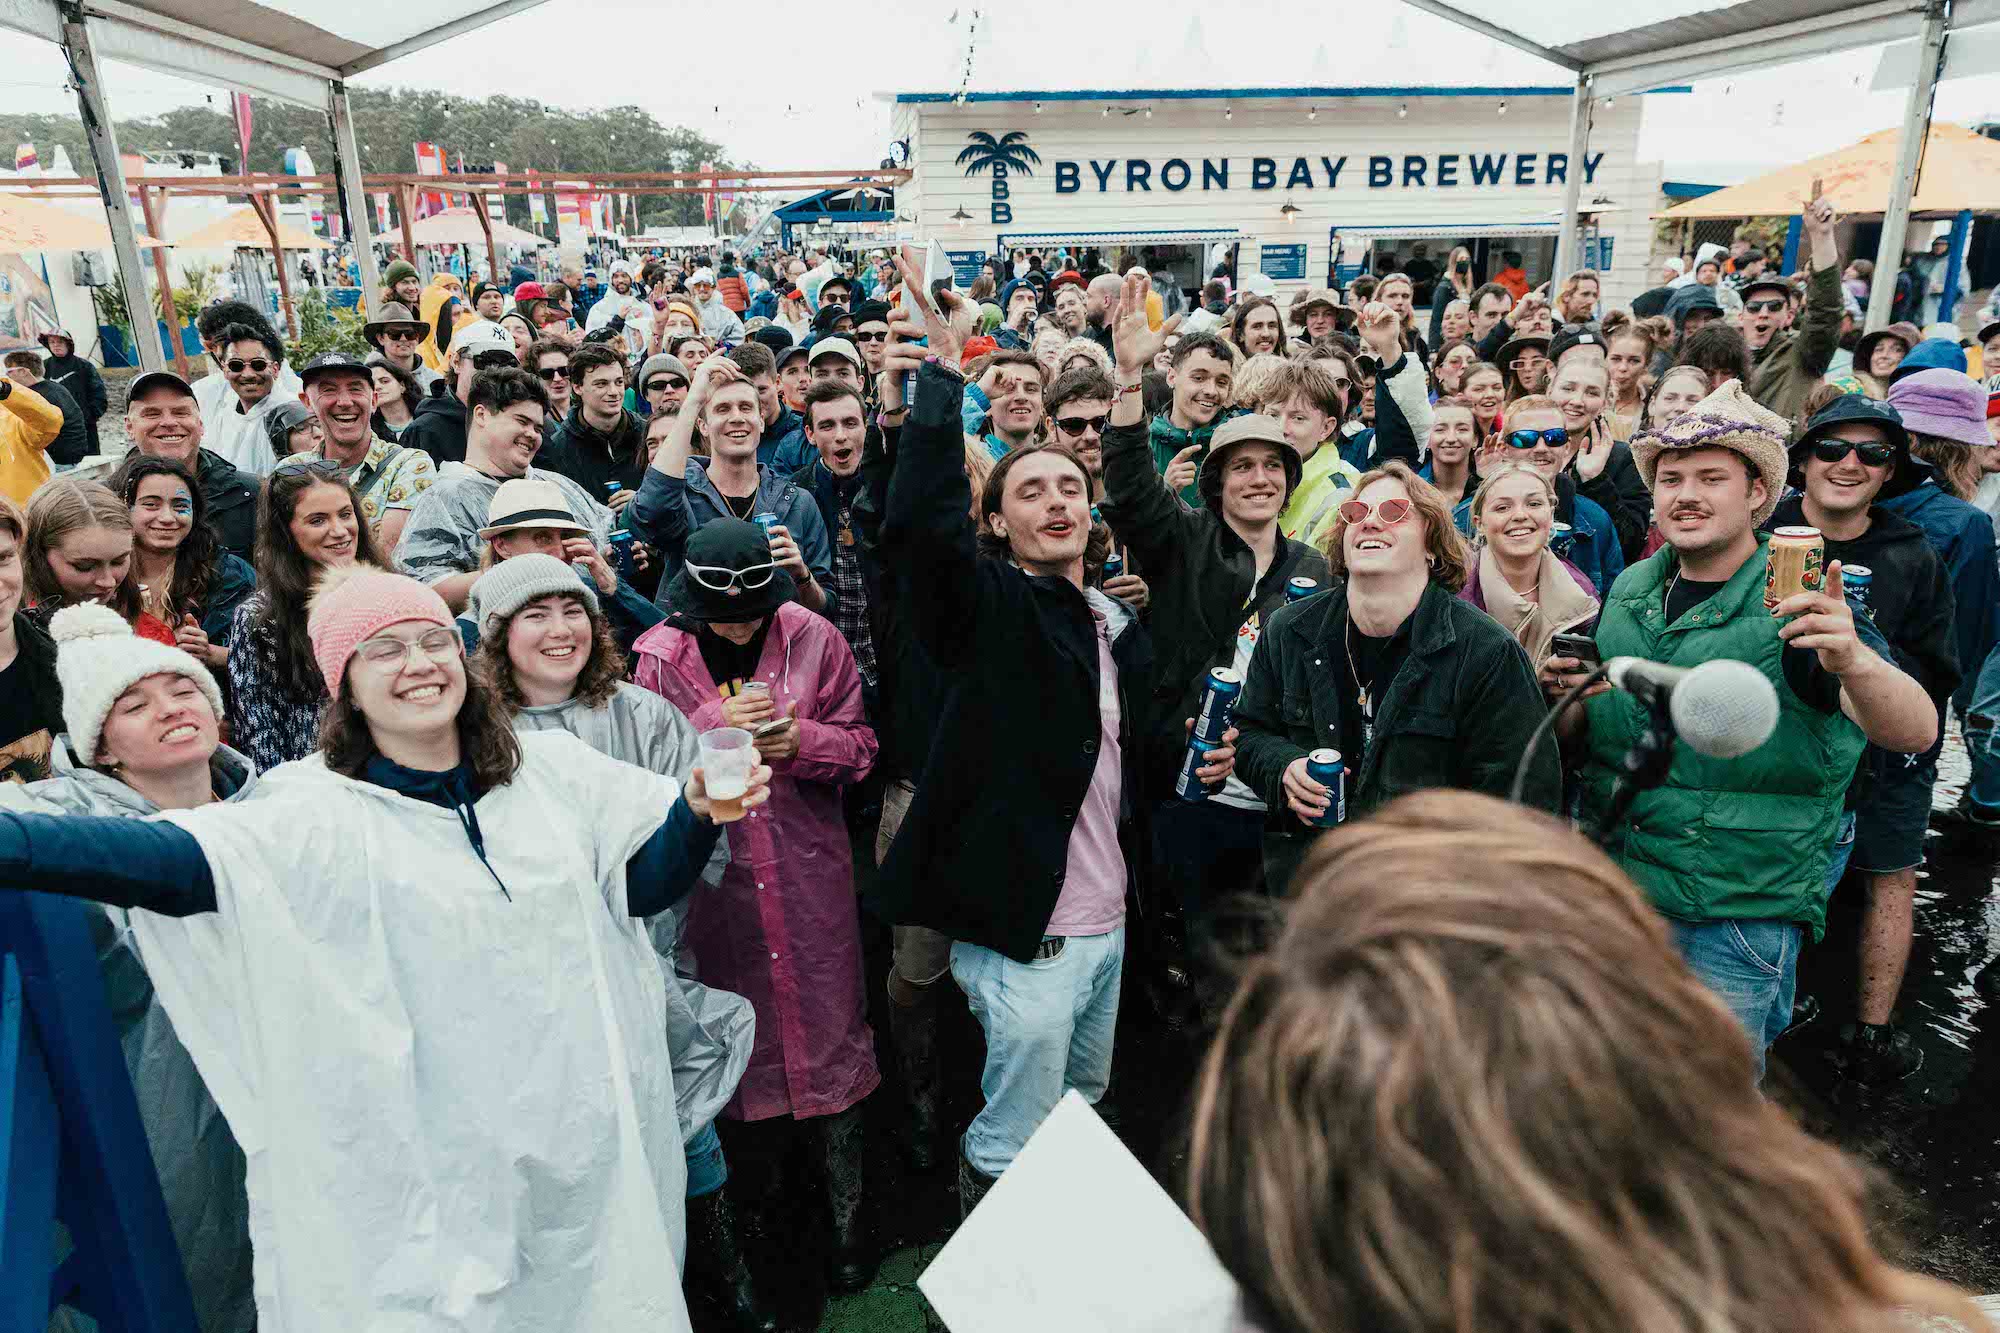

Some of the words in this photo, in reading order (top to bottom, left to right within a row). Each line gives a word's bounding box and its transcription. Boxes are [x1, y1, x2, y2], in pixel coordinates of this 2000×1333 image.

[1056, 158, 1229, 193] BYRON
[1252, 156, 1348, 189] BAY
[1368, 153, 1604, 187] BREWERY
[493, 327, 506, 341] NY
